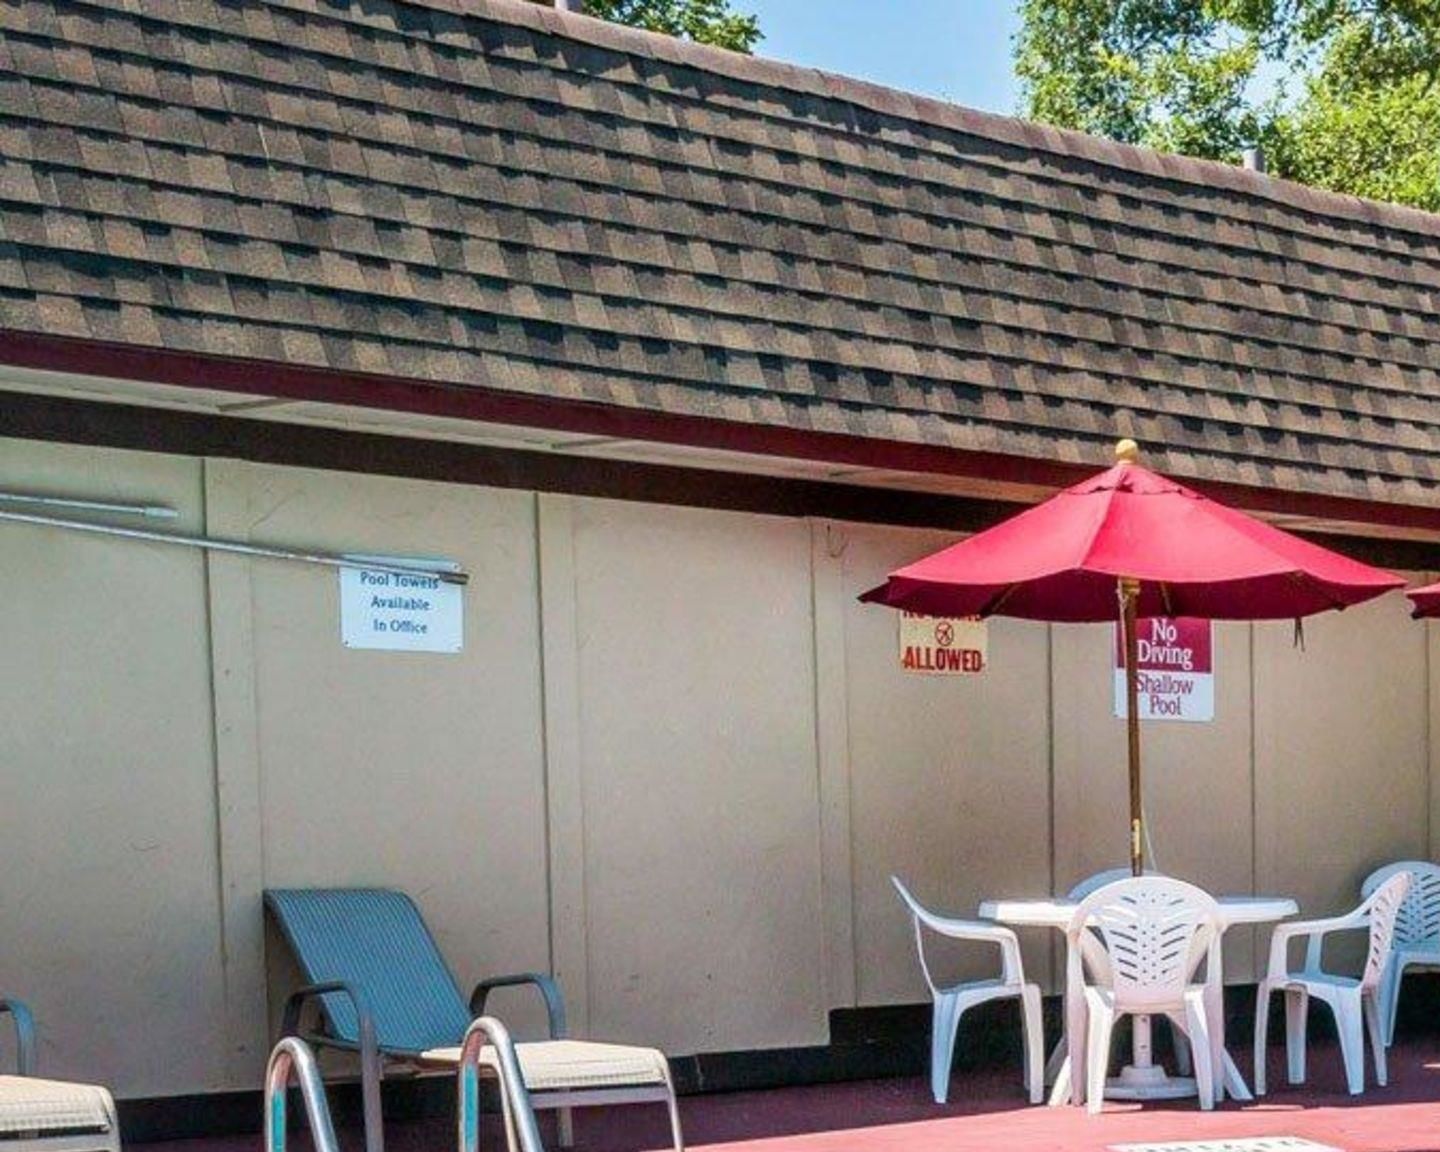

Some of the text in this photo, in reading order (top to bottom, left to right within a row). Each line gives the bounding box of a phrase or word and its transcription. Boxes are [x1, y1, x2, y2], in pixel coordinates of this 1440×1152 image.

[360, 571, 439, 589] Pool Towels
[371, 596, 430, 610] Available
[373, 620, 427, 634] In Office
[1151, 618, 1178, 642] No
[902, 646, 982, 672] ALLOWED
[1137, 639, 1194, 670] Diving
[1136, 672, 1194, 695] Shallow
[1150, 695, 1182, 715] Pool
